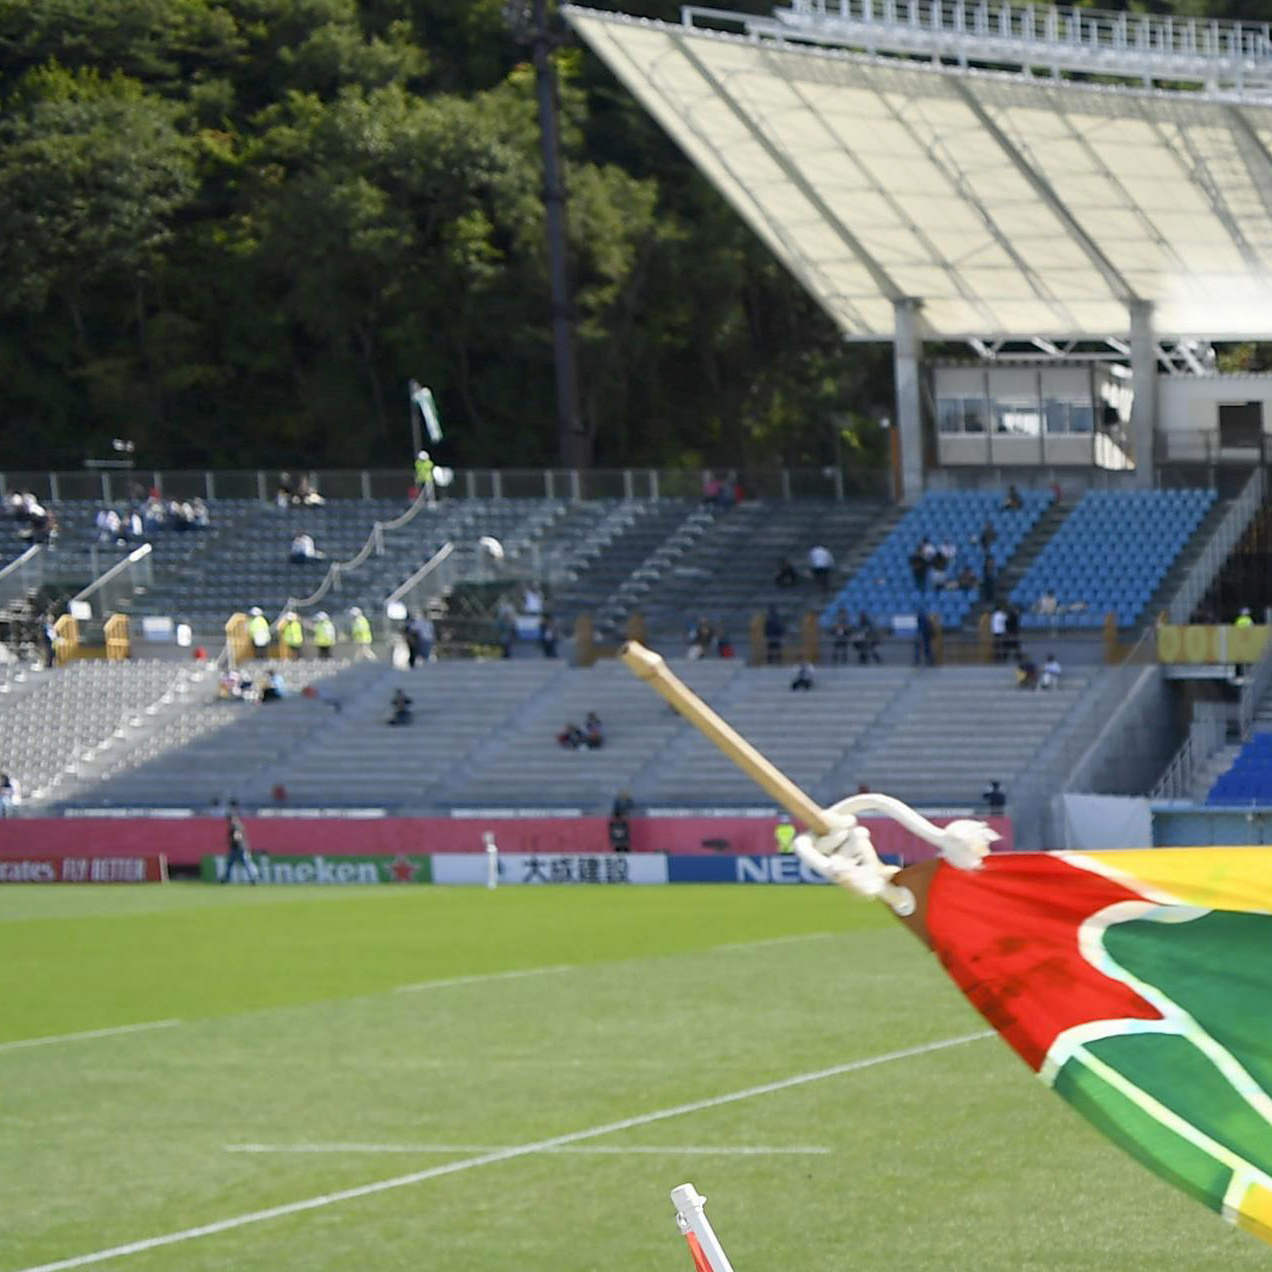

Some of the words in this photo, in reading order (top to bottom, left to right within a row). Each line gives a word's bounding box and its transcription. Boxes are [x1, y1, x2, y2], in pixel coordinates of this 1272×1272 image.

[63, 857, 87, 881] FLY
[91, 857, 146, 881] BETTER
[523, 856, 628, 883] 大成建設
